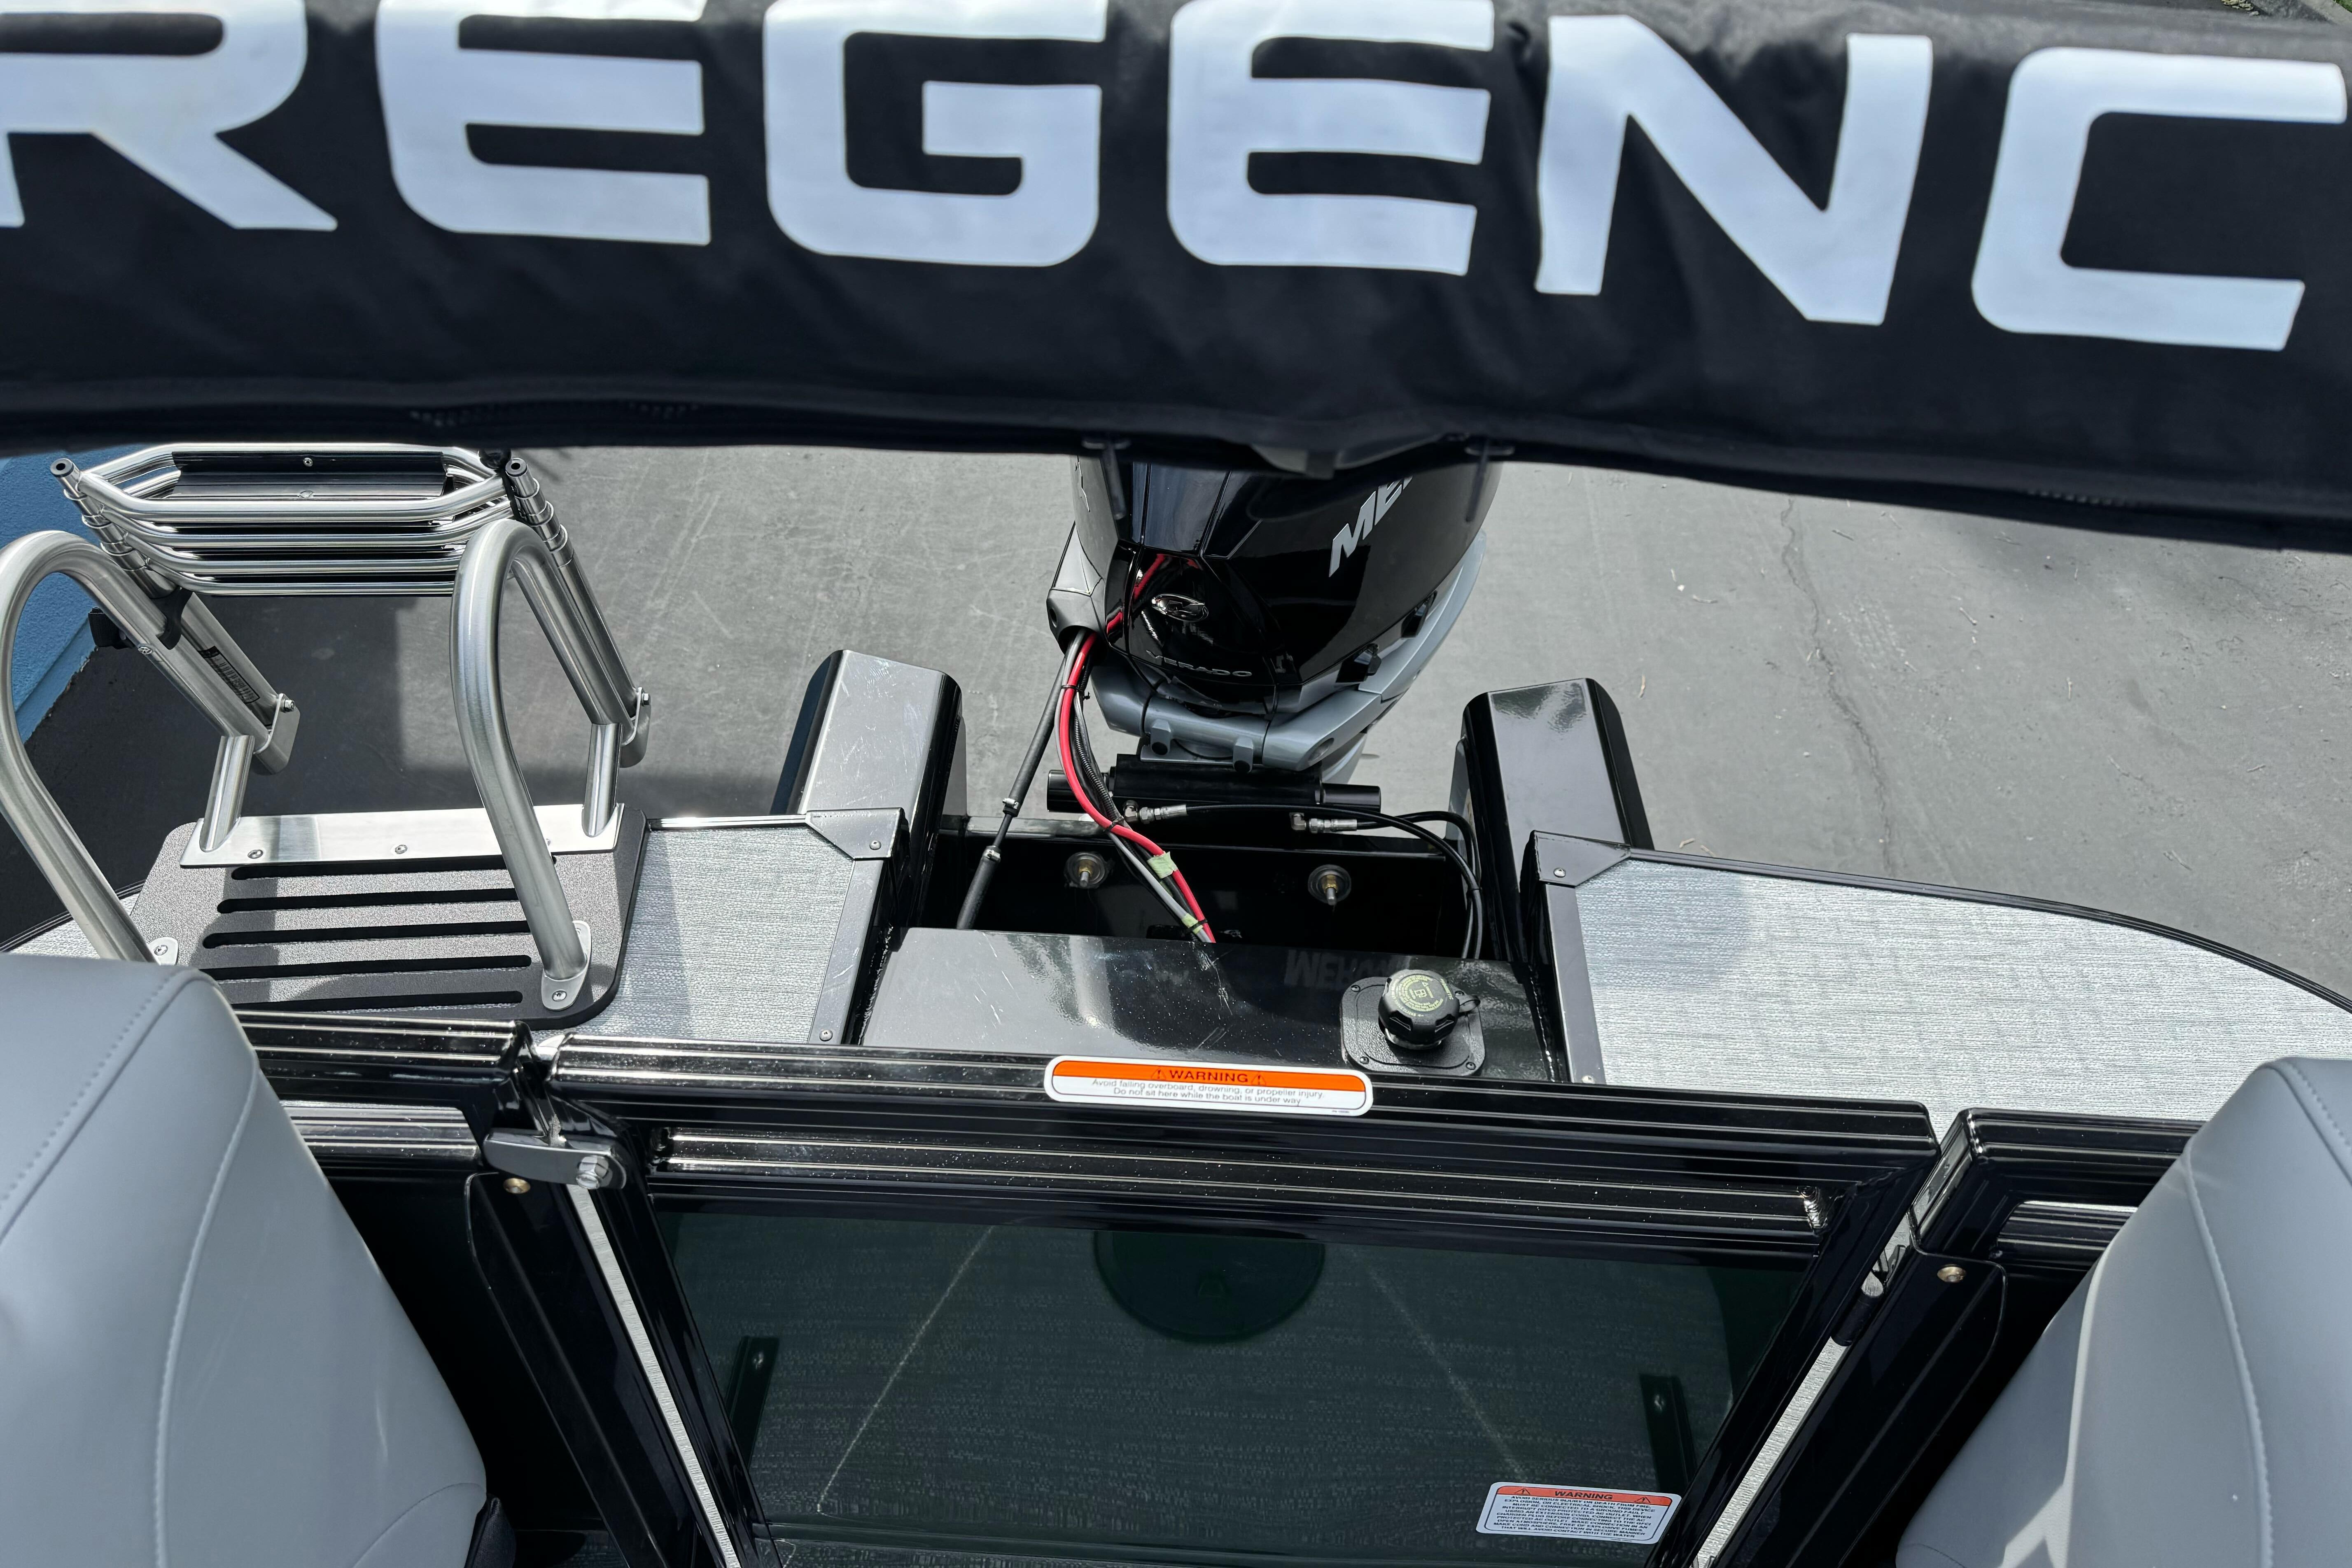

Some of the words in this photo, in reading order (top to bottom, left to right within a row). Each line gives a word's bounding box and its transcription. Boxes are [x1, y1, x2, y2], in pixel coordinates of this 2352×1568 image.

[0, 0, 2348, 351] REGENC
[1329, 475, 1413, 577] ME
[1146, 650, 1253, 677] VERADO
[1170, 1070, 1248, 1083] WARNING
[1092, 1078, 1117, 1087] Avoid
[1119, 1080, 1145, 1090] falling
[1148, 1082, 1196, 1092] overboard,
[1198, 1084, 1242, 1094] drowning,
[1298, 1090, 1325, 1099] injury.
[1283, 1098, 1301, 1106] way
[1555, 1491, 1612, 1500] WARNING
